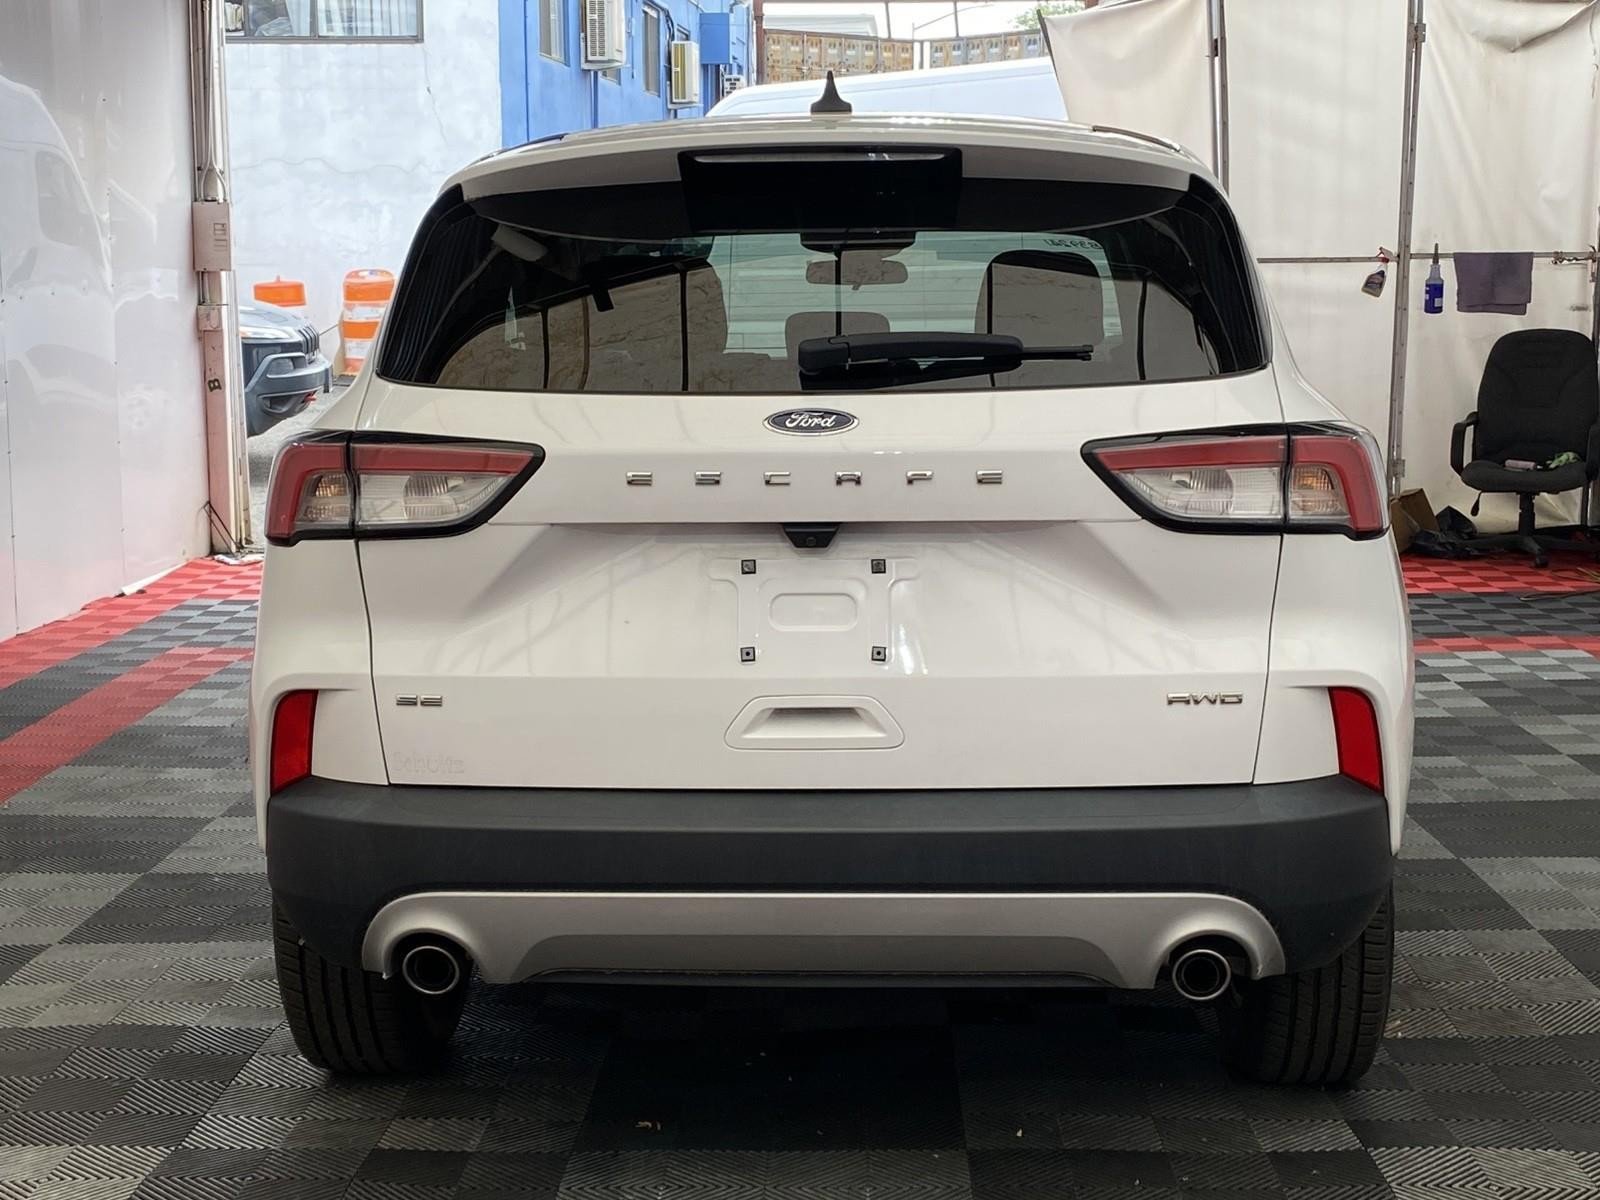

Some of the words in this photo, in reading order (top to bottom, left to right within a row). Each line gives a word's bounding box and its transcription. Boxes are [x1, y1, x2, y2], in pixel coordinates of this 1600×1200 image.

[785, 412, 836, 427] Ford
[626, 470, 1004, 486] ESCAPE
[396, 694, 443, 707] SE
[1167, 692, 1243, 705] AWD
